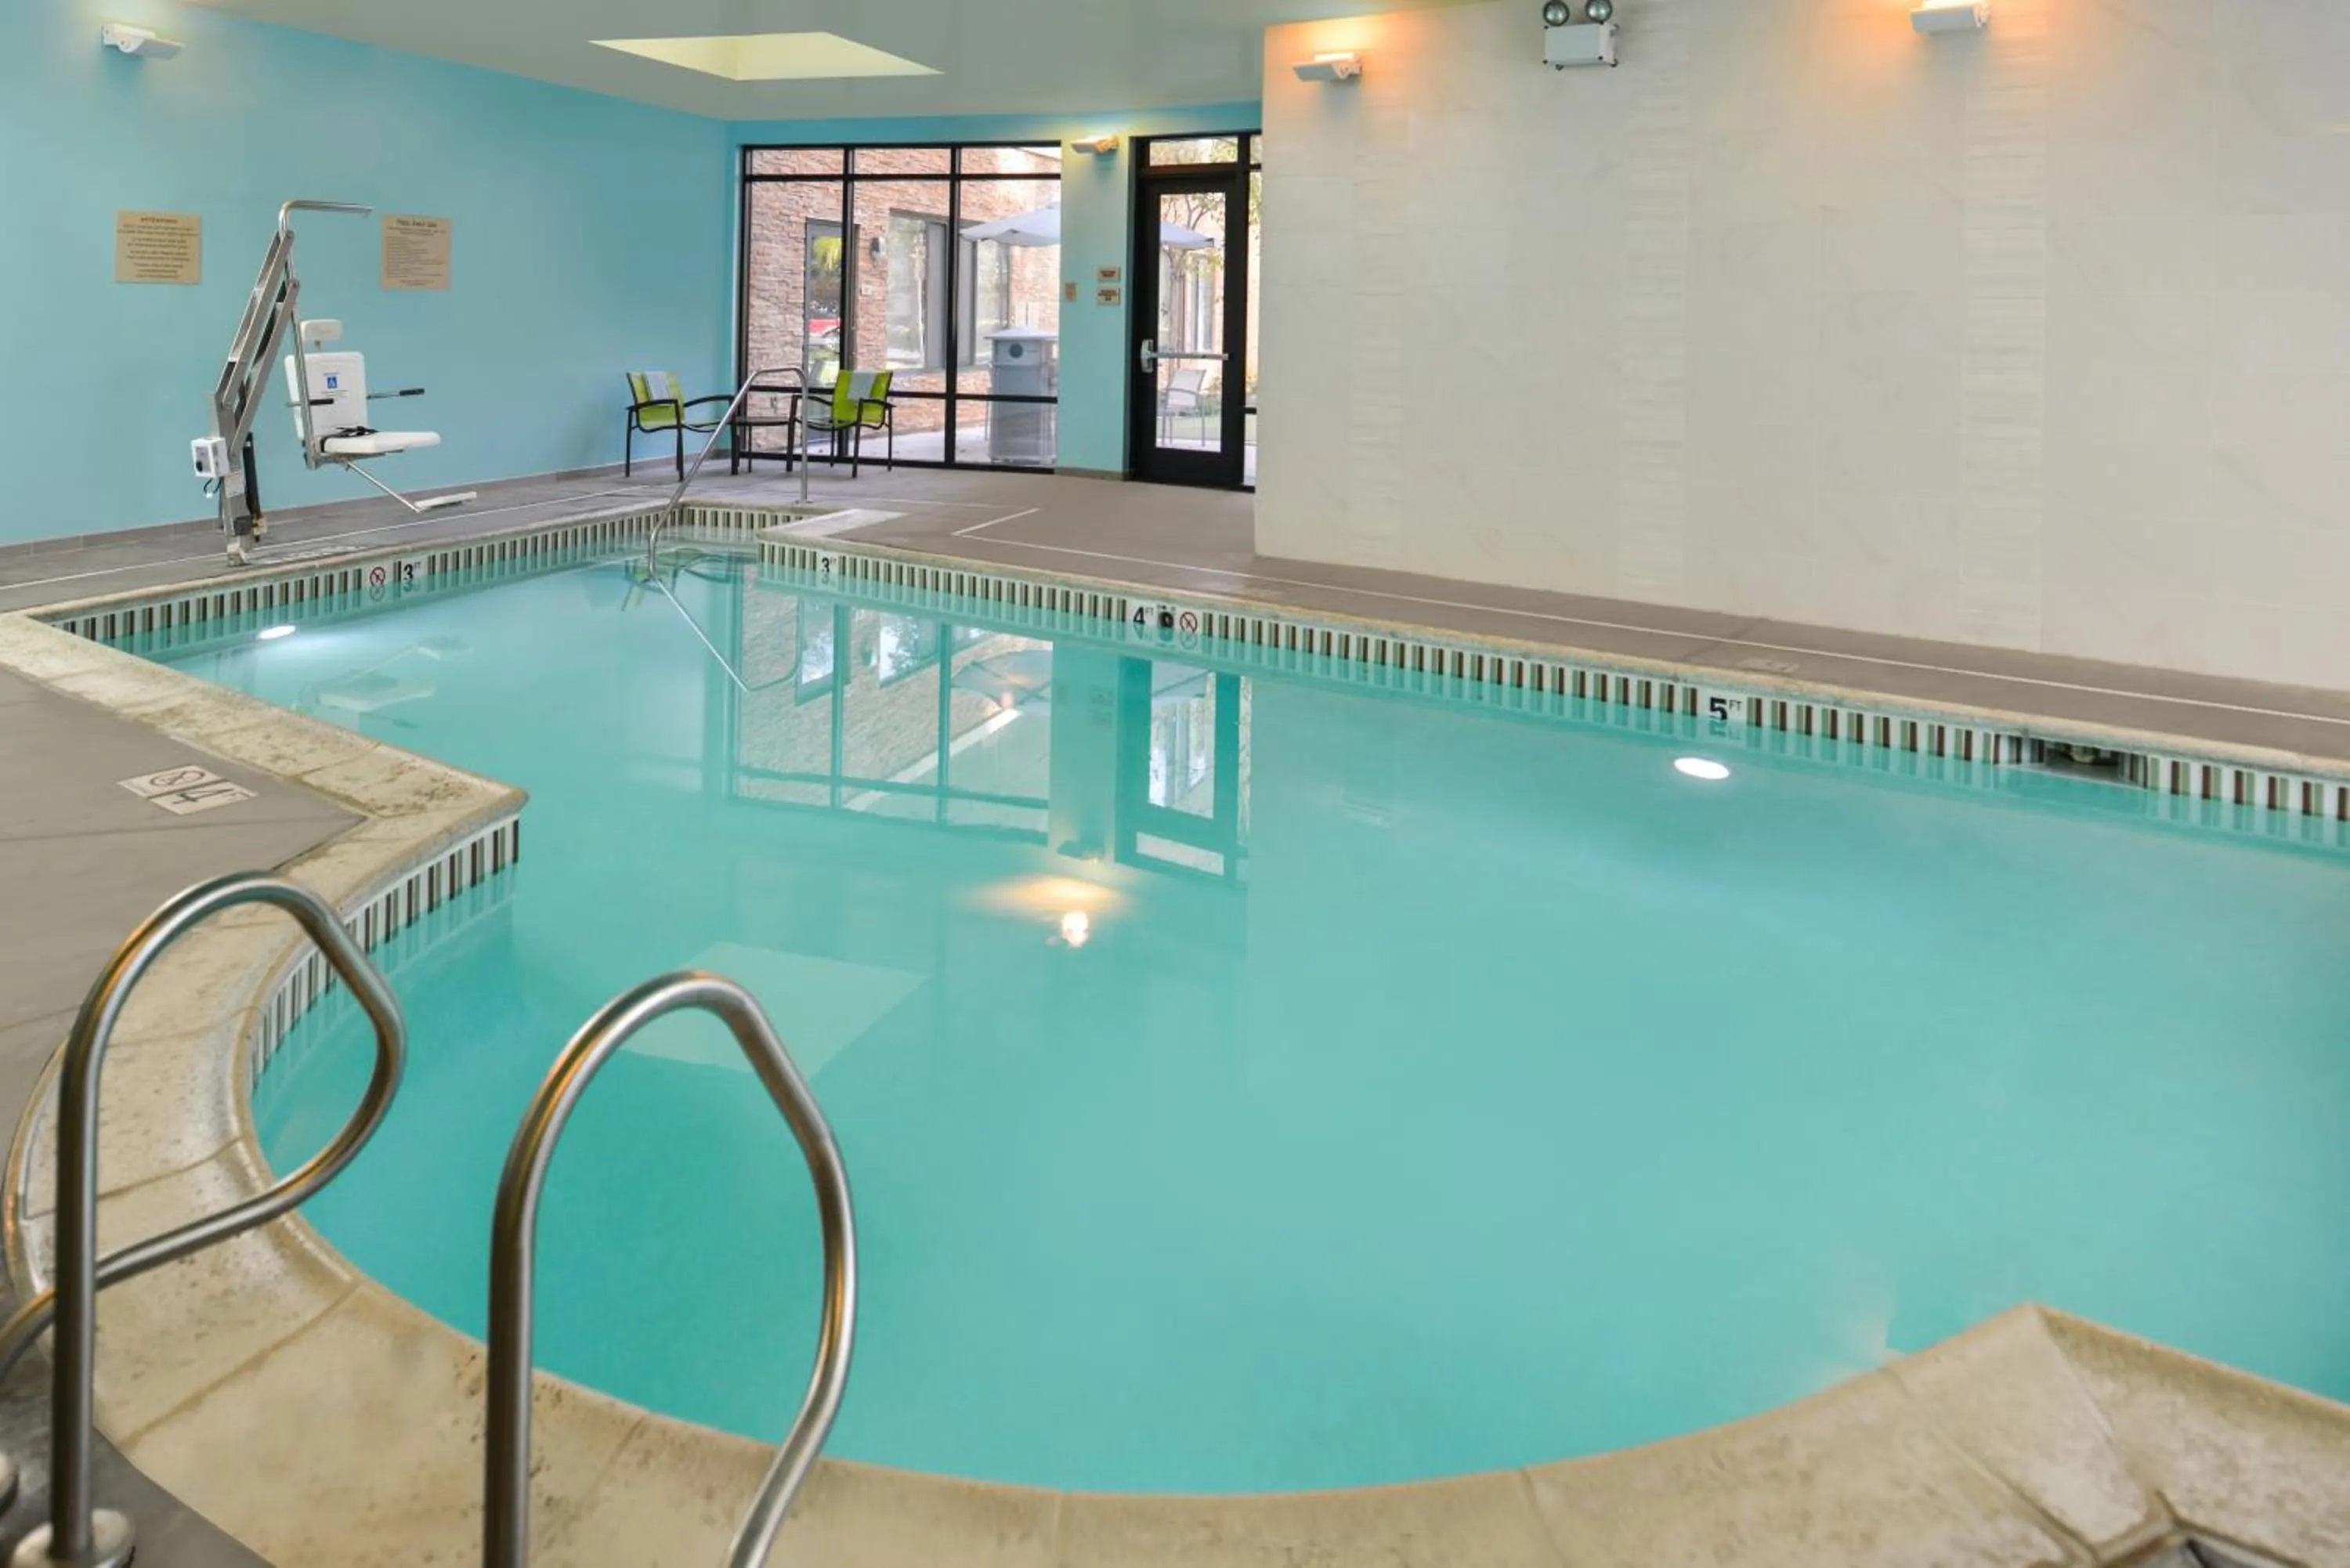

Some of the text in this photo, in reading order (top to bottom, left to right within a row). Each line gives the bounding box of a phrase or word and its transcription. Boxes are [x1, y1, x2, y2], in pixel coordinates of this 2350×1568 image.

[822, 557, 830, 573] 3
[1133, 606, 1146, 624] 4
[1709, 696, 1743, 721] 5 FT
